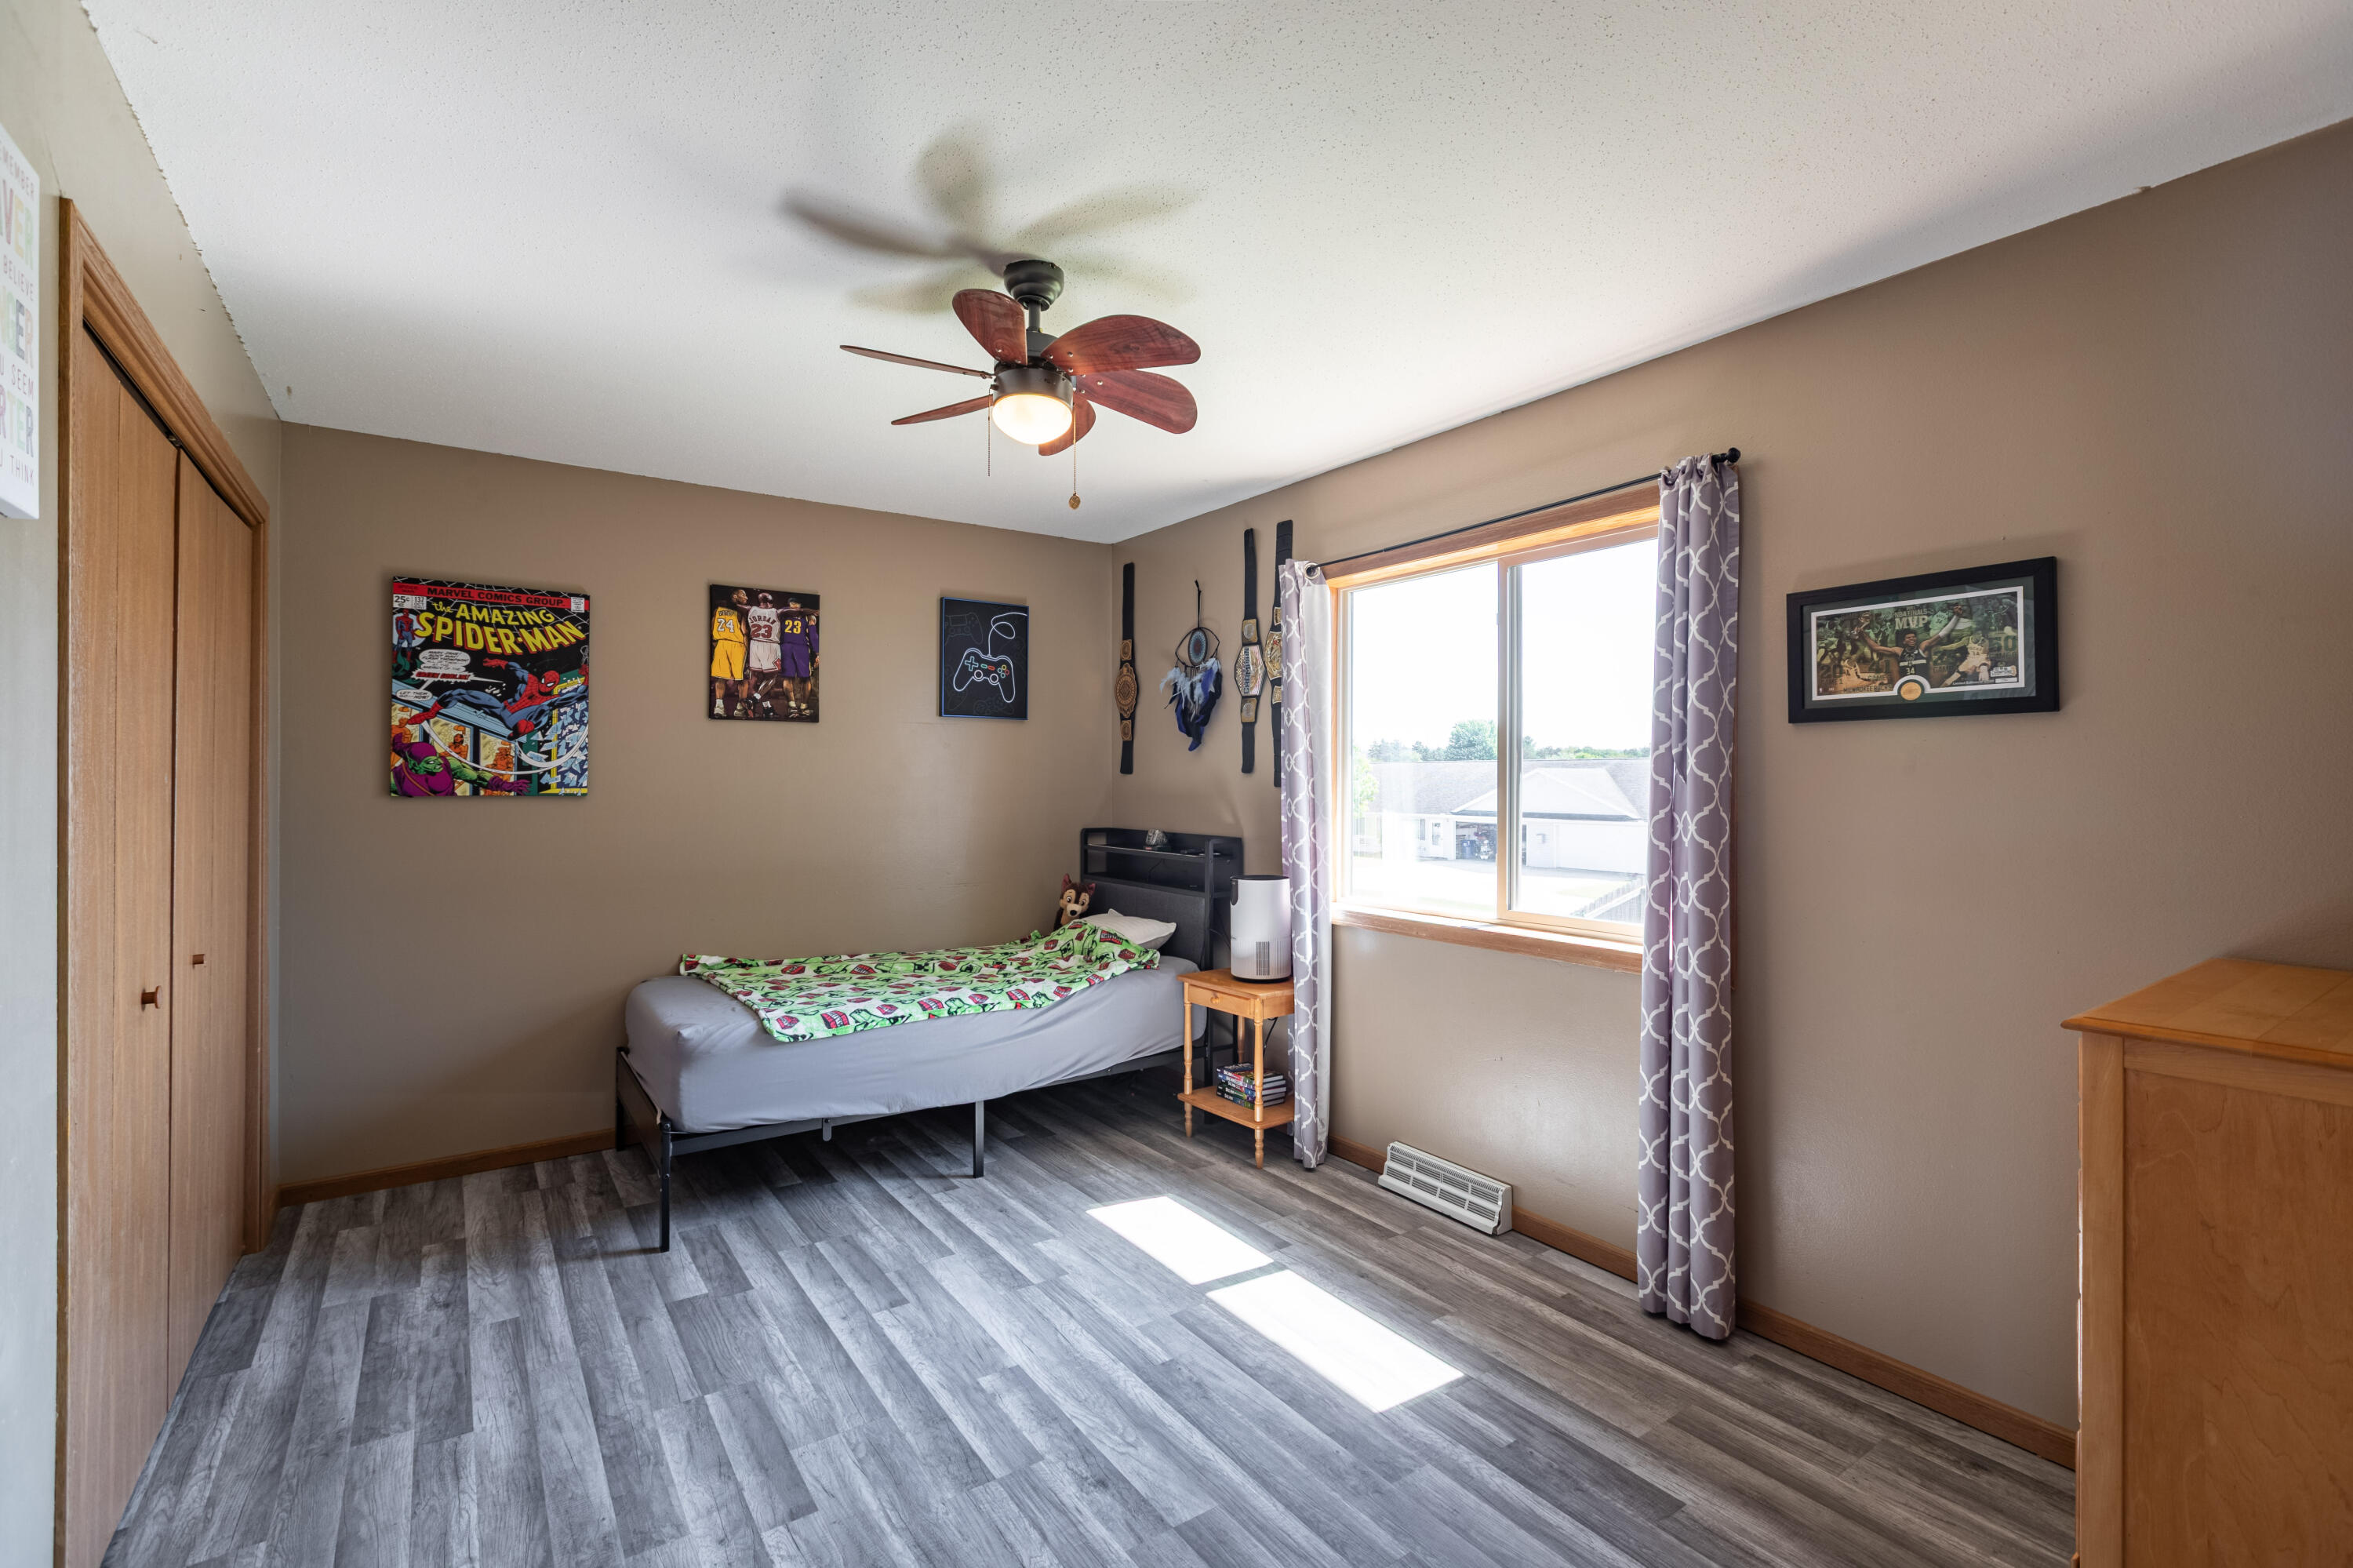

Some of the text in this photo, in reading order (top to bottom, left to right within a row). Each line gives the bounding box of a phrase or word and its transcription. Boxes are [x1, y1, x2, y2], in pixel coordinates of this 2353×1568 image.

[3, 254, 34, 302] BELIEVE
[12, 363, 34, 402] SEEM
[9, 454, 34, 487] THINK
[427, 587, 474, 598] MARVEL
[478, 591, 522, 603] COMICS
[432, 601, 453, 613] the
[456, 603, 555, 626] AMAZING
[748, 615, 776, 625] JORDAN
[718, 618, 735, 633] 24
[784, 620, 802, 634] 23
[1895, 615, 1929, 630] MVP
[413, 612, 587, 655] SPIDER-MAN
[751, 624, 773, 638] 23
